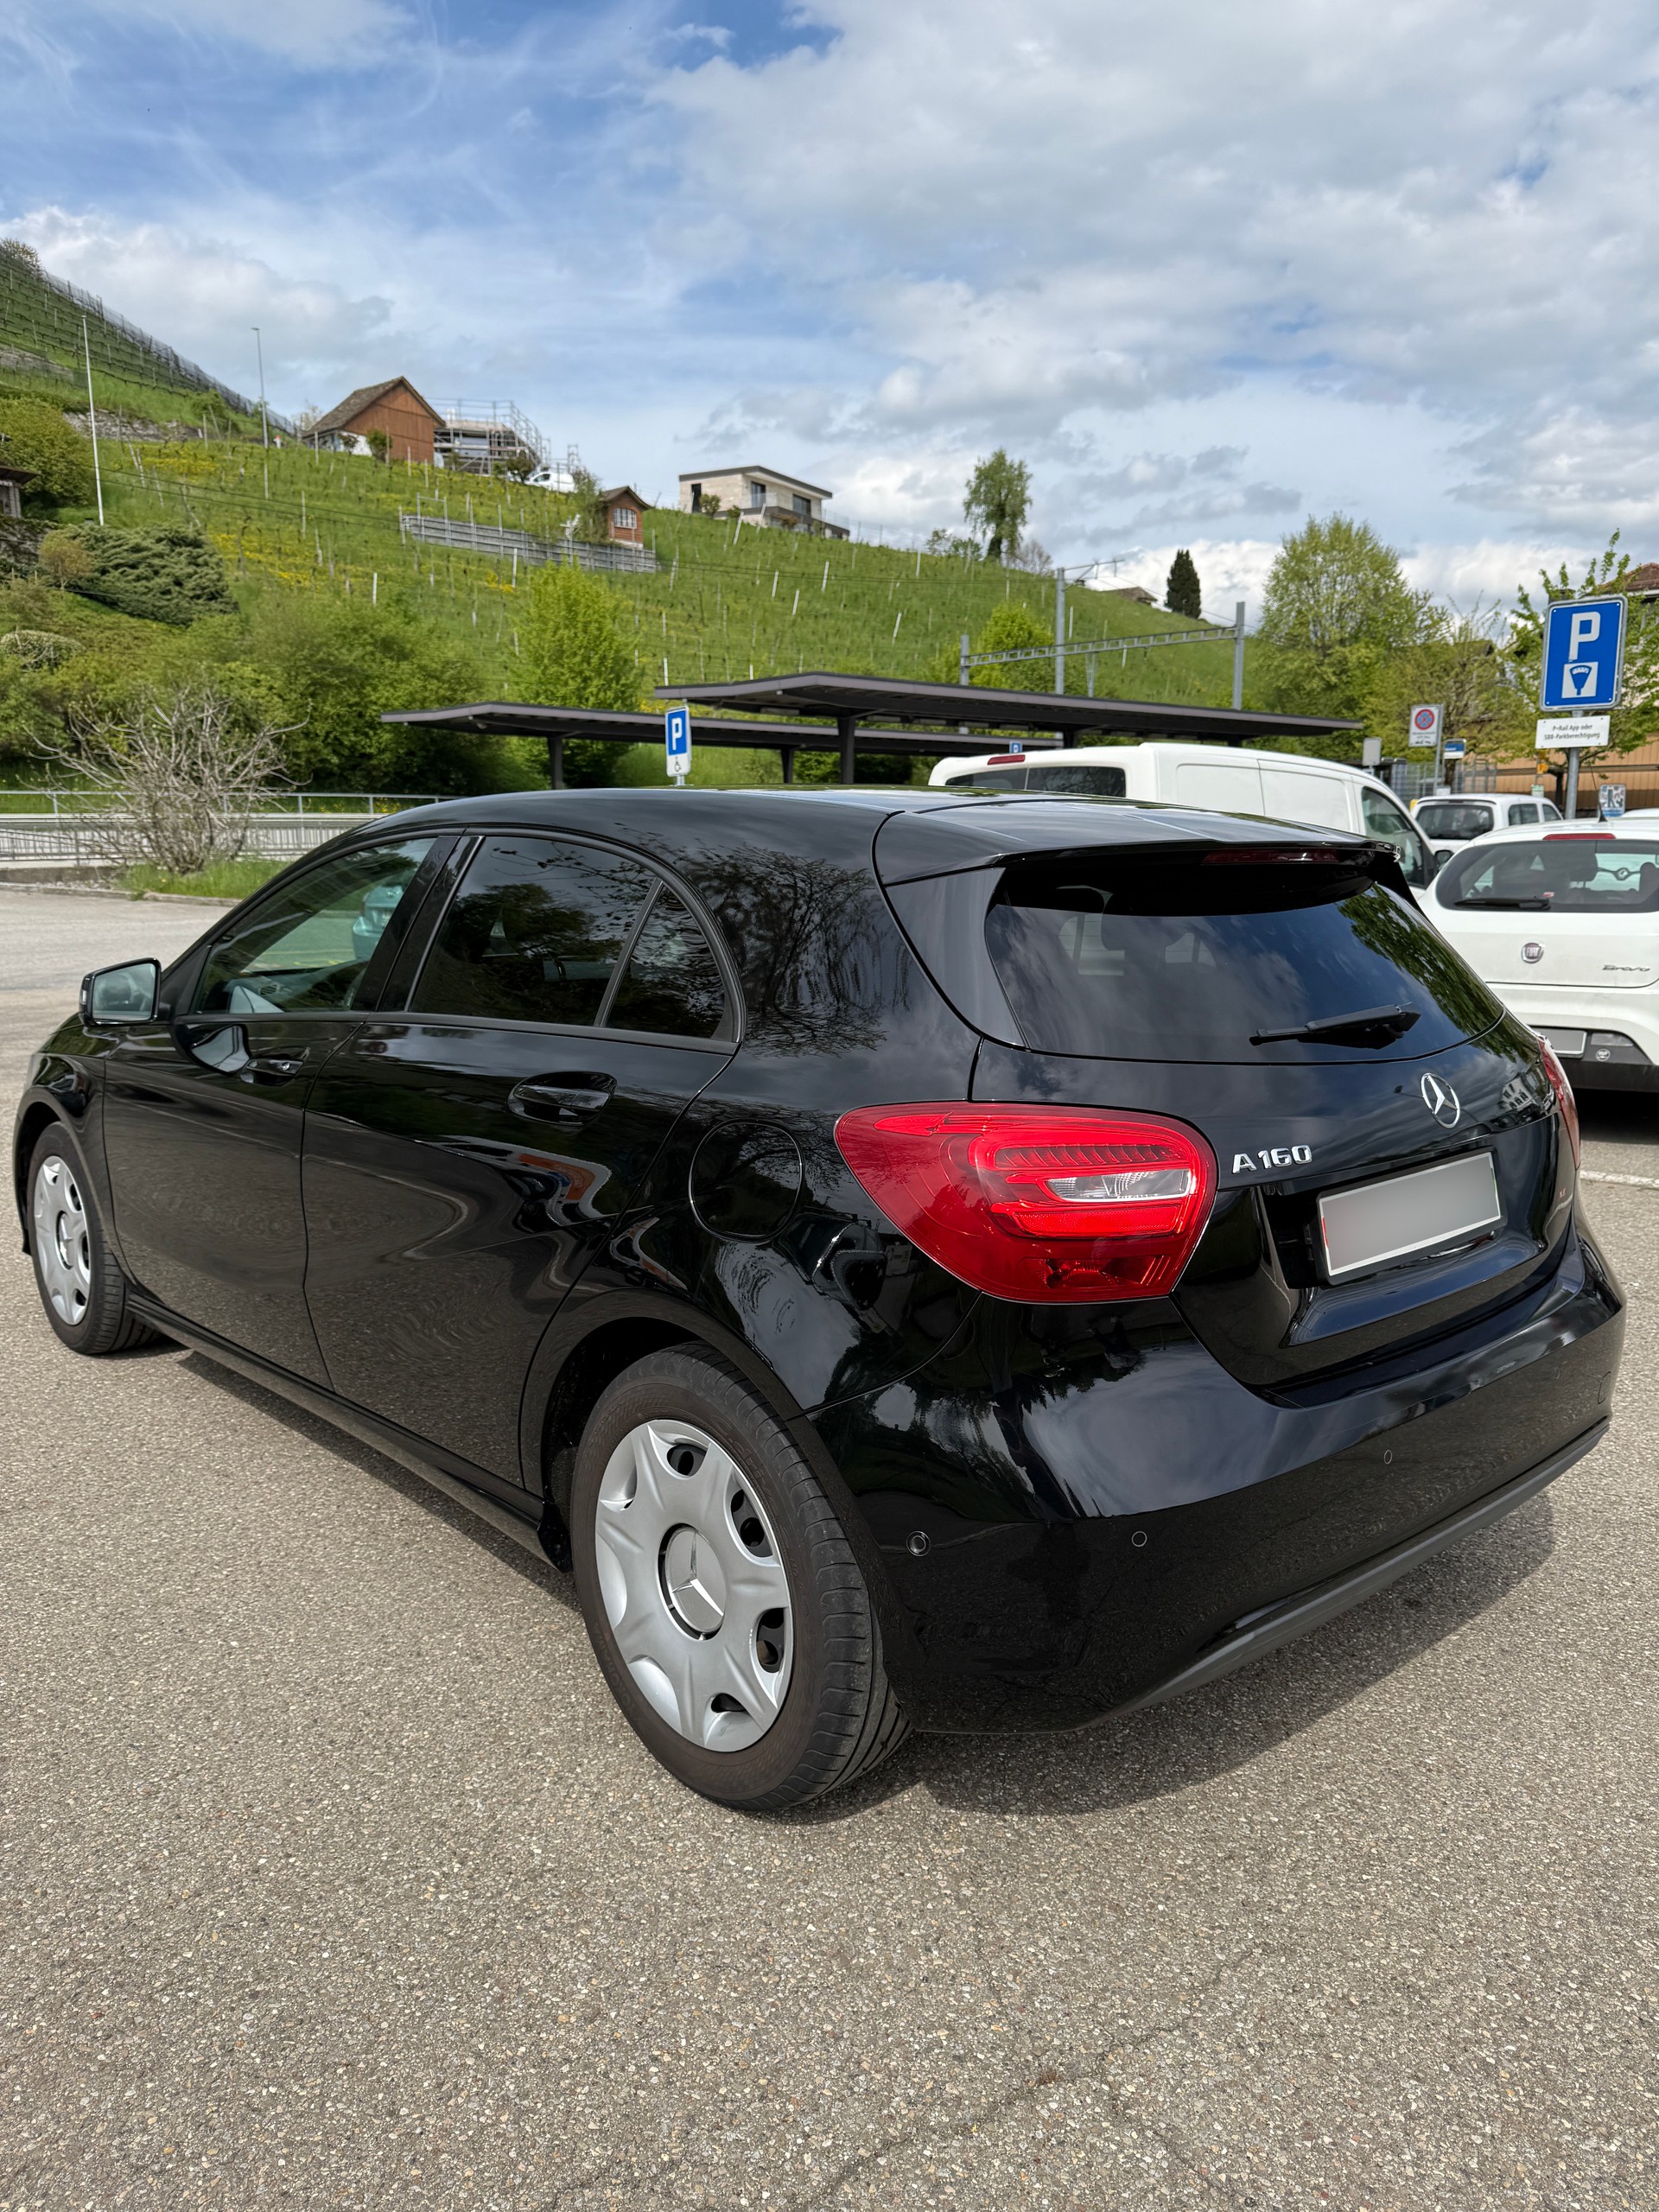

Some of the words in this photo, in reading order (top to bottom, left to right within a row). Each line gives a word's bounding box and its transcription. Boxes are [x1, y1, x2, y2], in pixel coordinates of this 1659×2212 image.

[1568, 612, 1601, 662] P
[671, 717, 683, 751] P
[1544, 732, 1600, 741] SBB-Parkberechtigung
[1526, 947, 1540, 957] FIAT
[1232, 1154, 1257, 1174] A
[1257, 1145, 1313, 1169] 160
